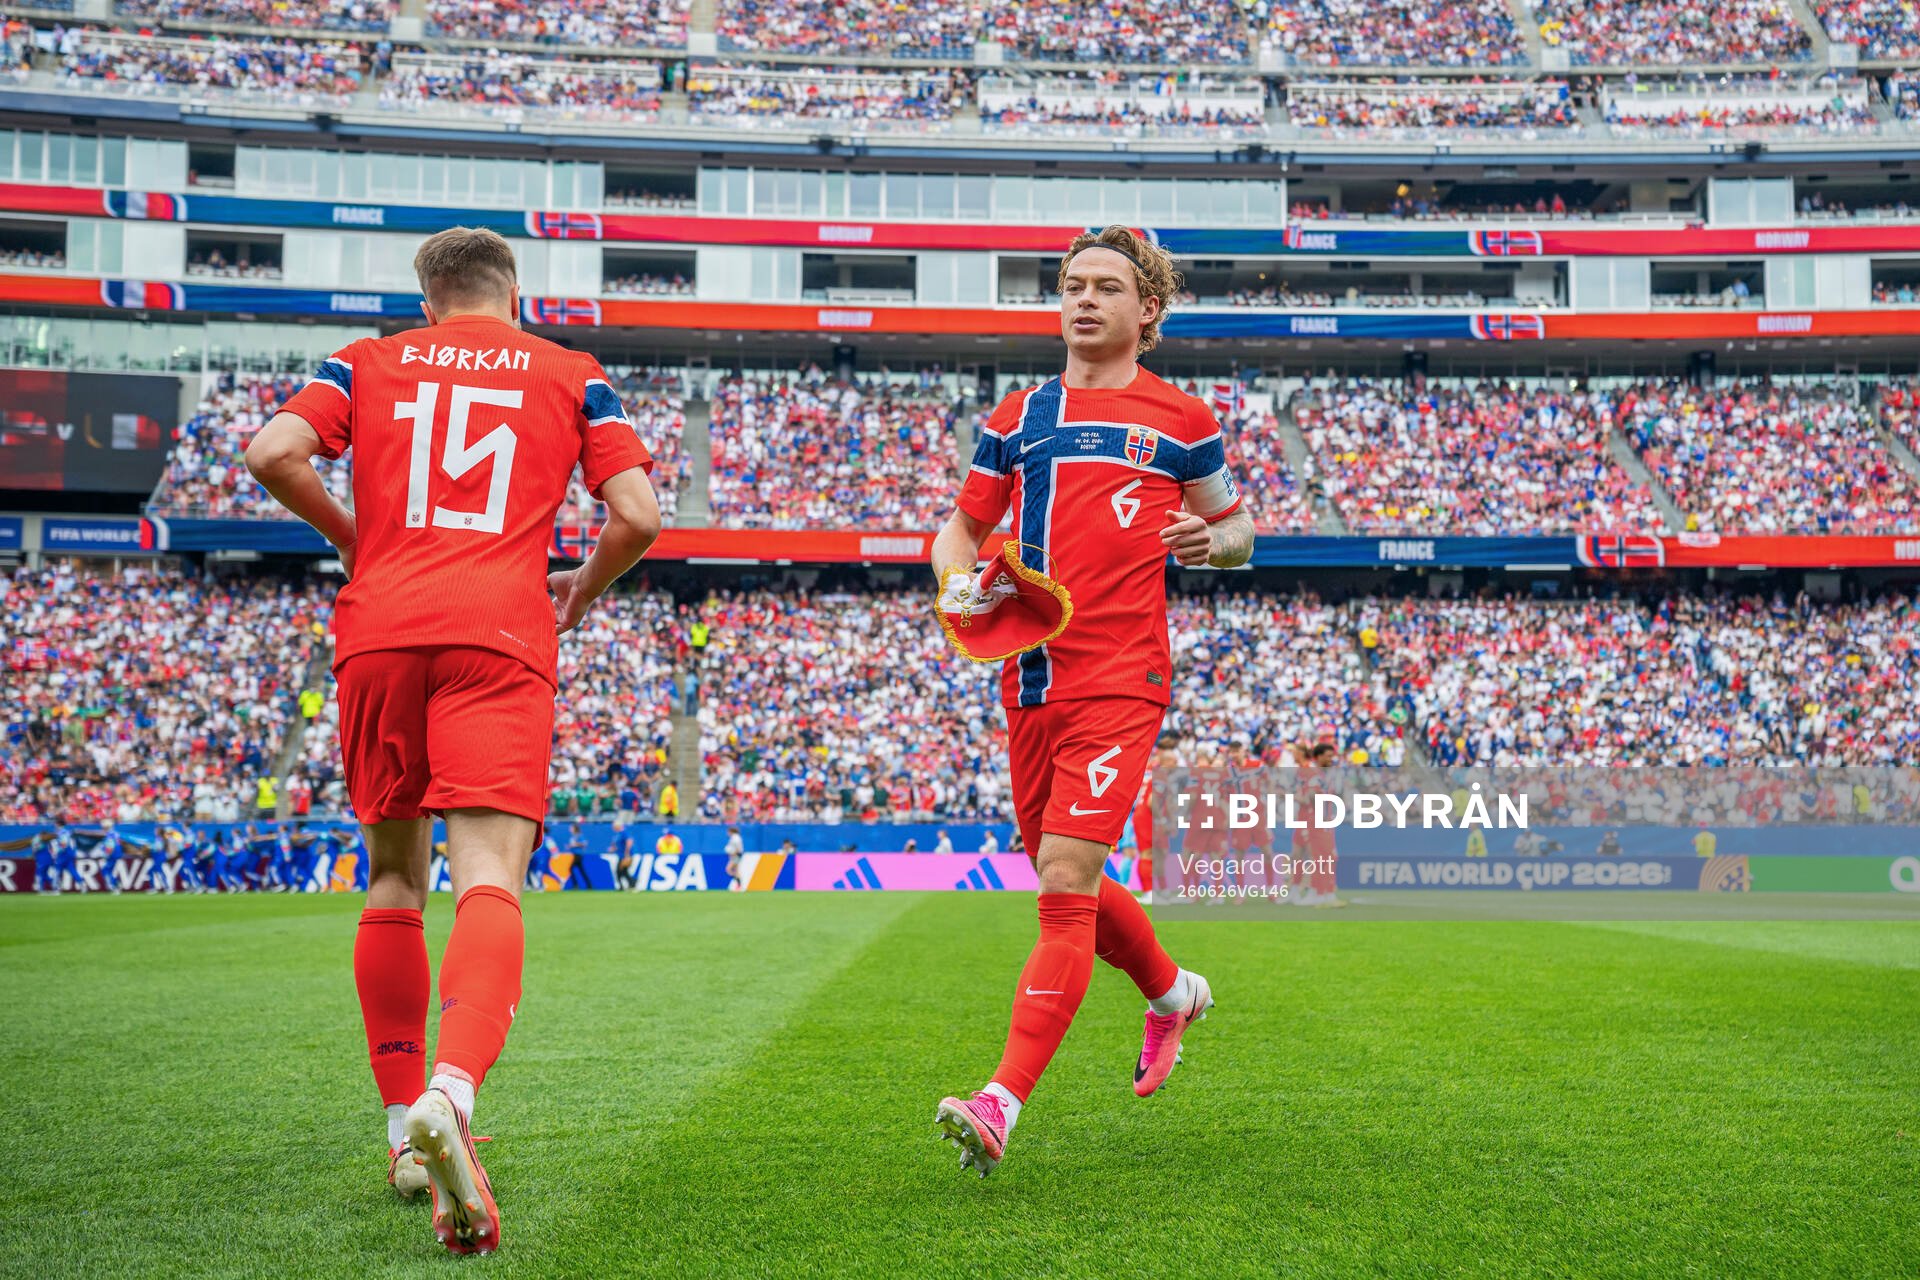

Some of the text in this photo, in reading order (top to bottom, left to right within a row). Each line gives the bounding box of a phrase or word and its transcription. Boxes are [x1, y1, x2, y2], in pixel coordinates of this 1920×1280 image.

[333, 206, 384, 225] FRANCE
[331, 293, 383, 312] FRANCE
[1290, 316, 1338, 334] FRANCE
[401, 344, 531, 371] BJØRKAN
[393, 381, 524, 535] 15
[1111, 478, 1143, 528] 6
[1379, 541, 1435, 561] FRANCE
[1087, 745, 1123, 798] 6
[600, 853, 708, 890] VISA
[1359, 862, 1416, 884] FIFA
[1416, 862, 1513, 885] WORLD
[1571, 862, 1663, 885] 2026
